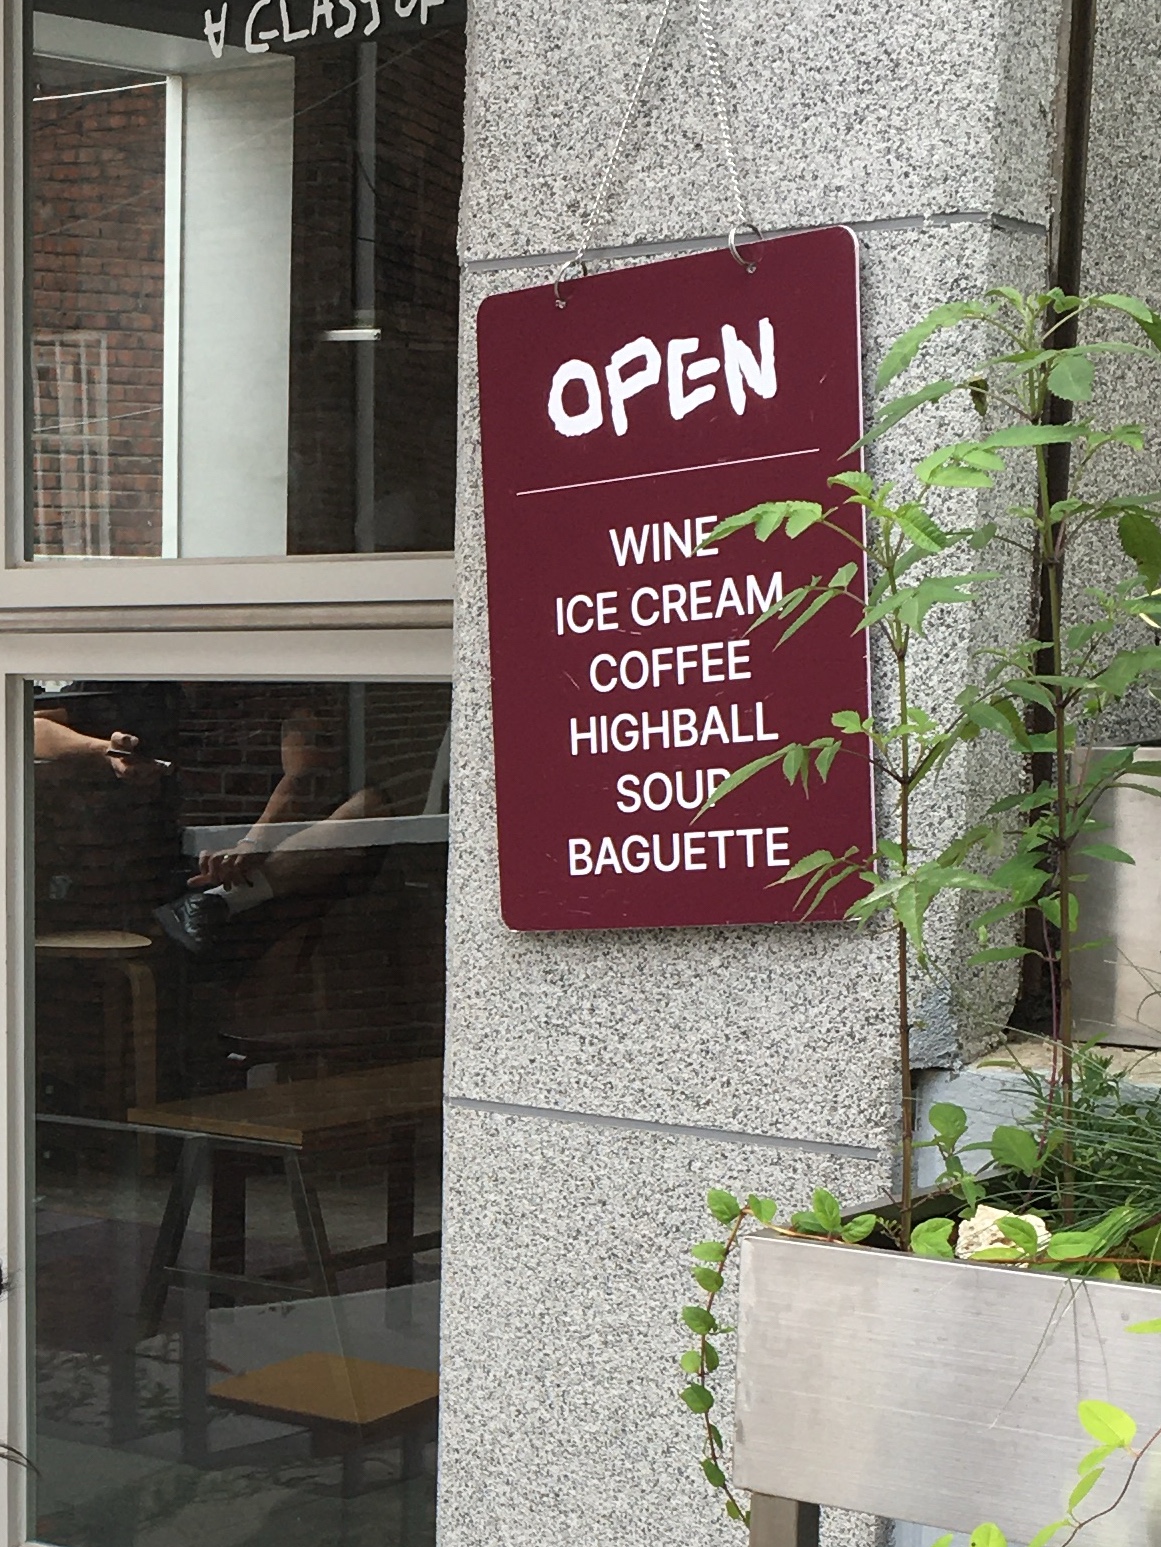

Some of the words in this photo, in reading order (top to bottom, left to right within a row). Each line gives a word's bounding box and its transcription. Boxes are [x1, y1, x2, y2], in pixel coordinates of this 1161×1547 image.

[244, 0, 380, 53] GLASS
[547, 317, 778, 437] OPEN
[609, 515, 719, 567] WINE
[556, 591, 619, 636] ICE
[631, 571, 783, 627] CREAM
[589, 639, 752, 693] COFFEE
[570, 701, 779, 756] HIGHBALL
[616, 768, 732, 813] SOUP
[568, 826, 790, 876] BAGUETTE
